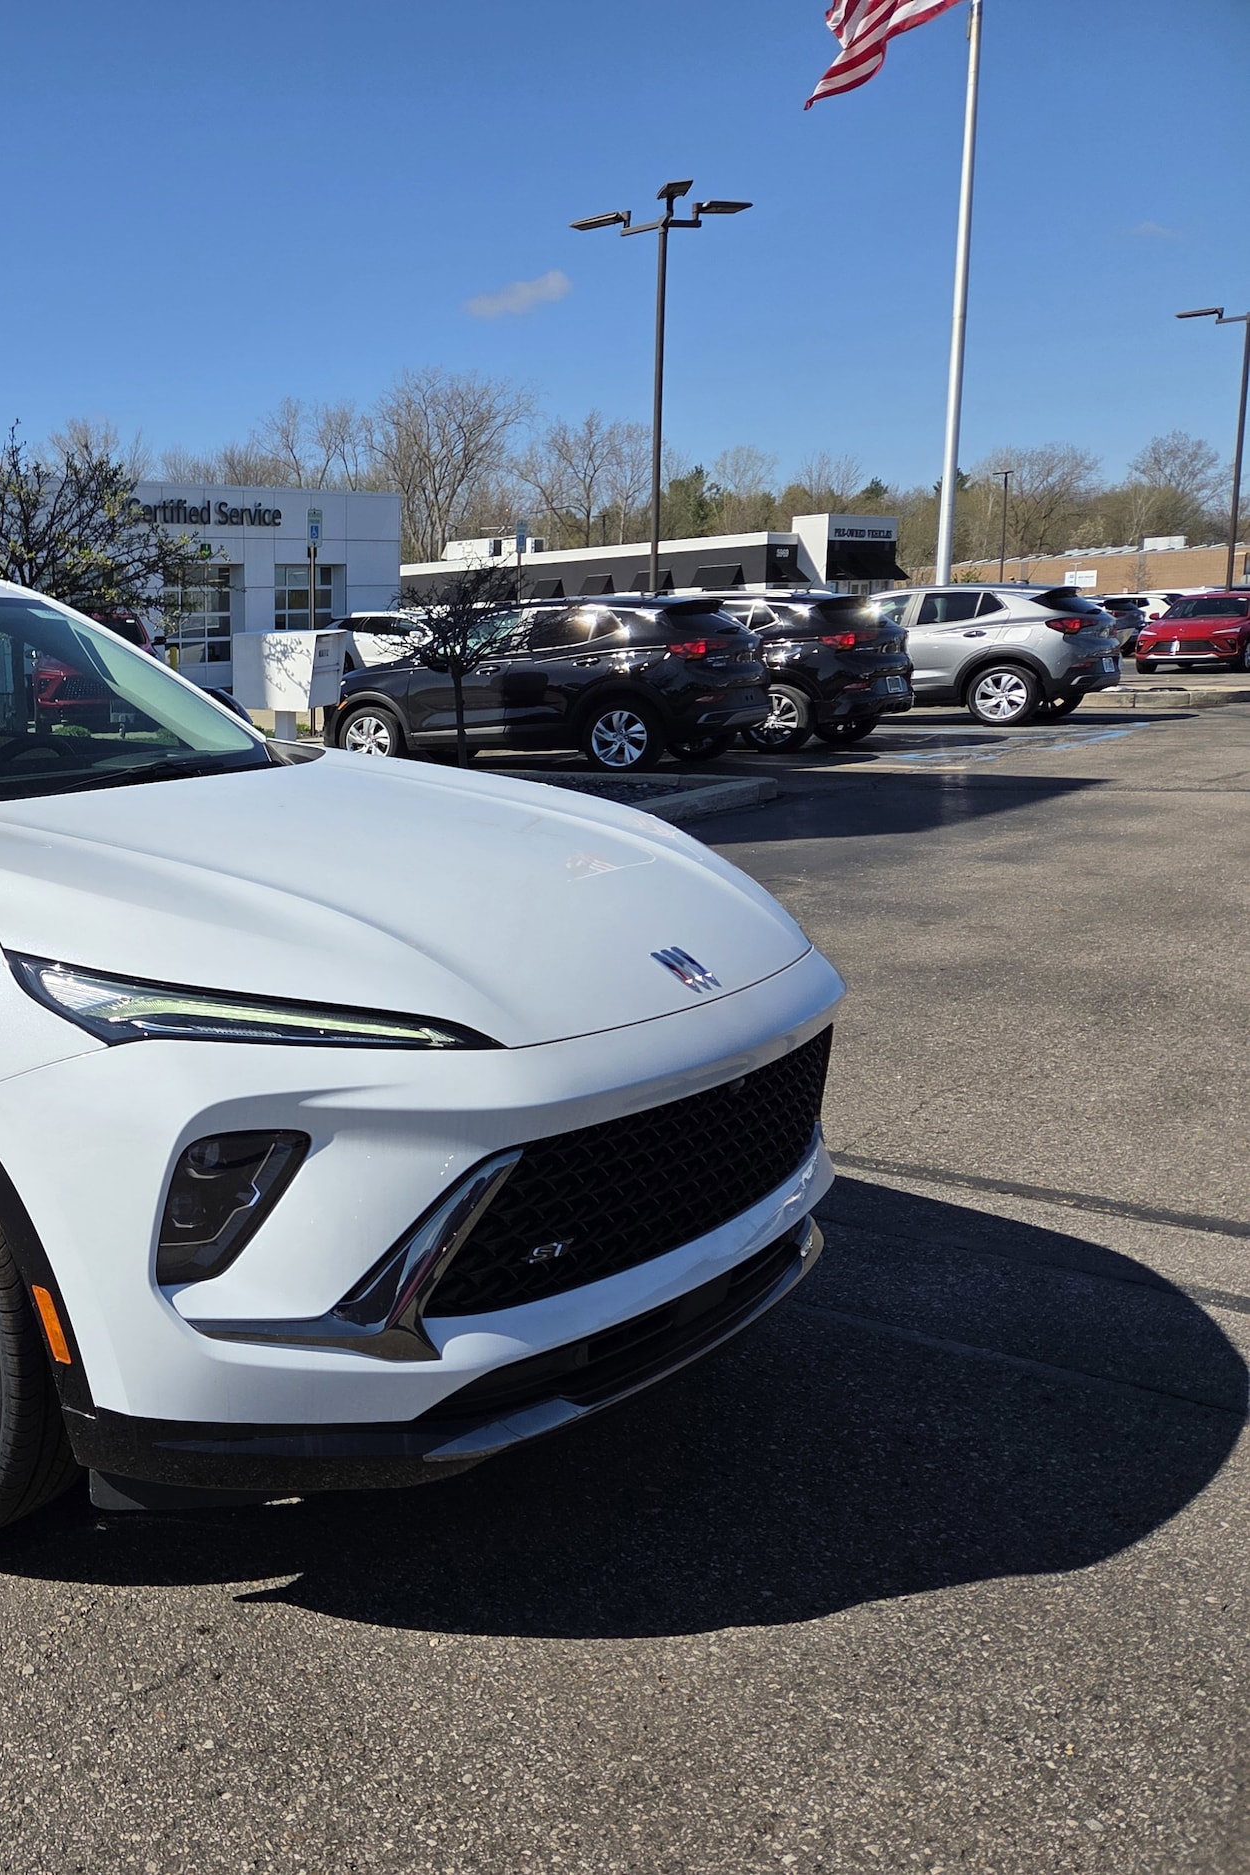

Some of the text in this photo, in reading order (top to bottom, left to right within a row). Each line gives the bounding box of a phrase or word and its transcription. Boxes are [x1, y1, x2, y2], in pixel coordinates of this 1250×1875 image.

[128, 498, 282, 526] Certified Service
[834, 528, 866, 538] PRE-OWNED
